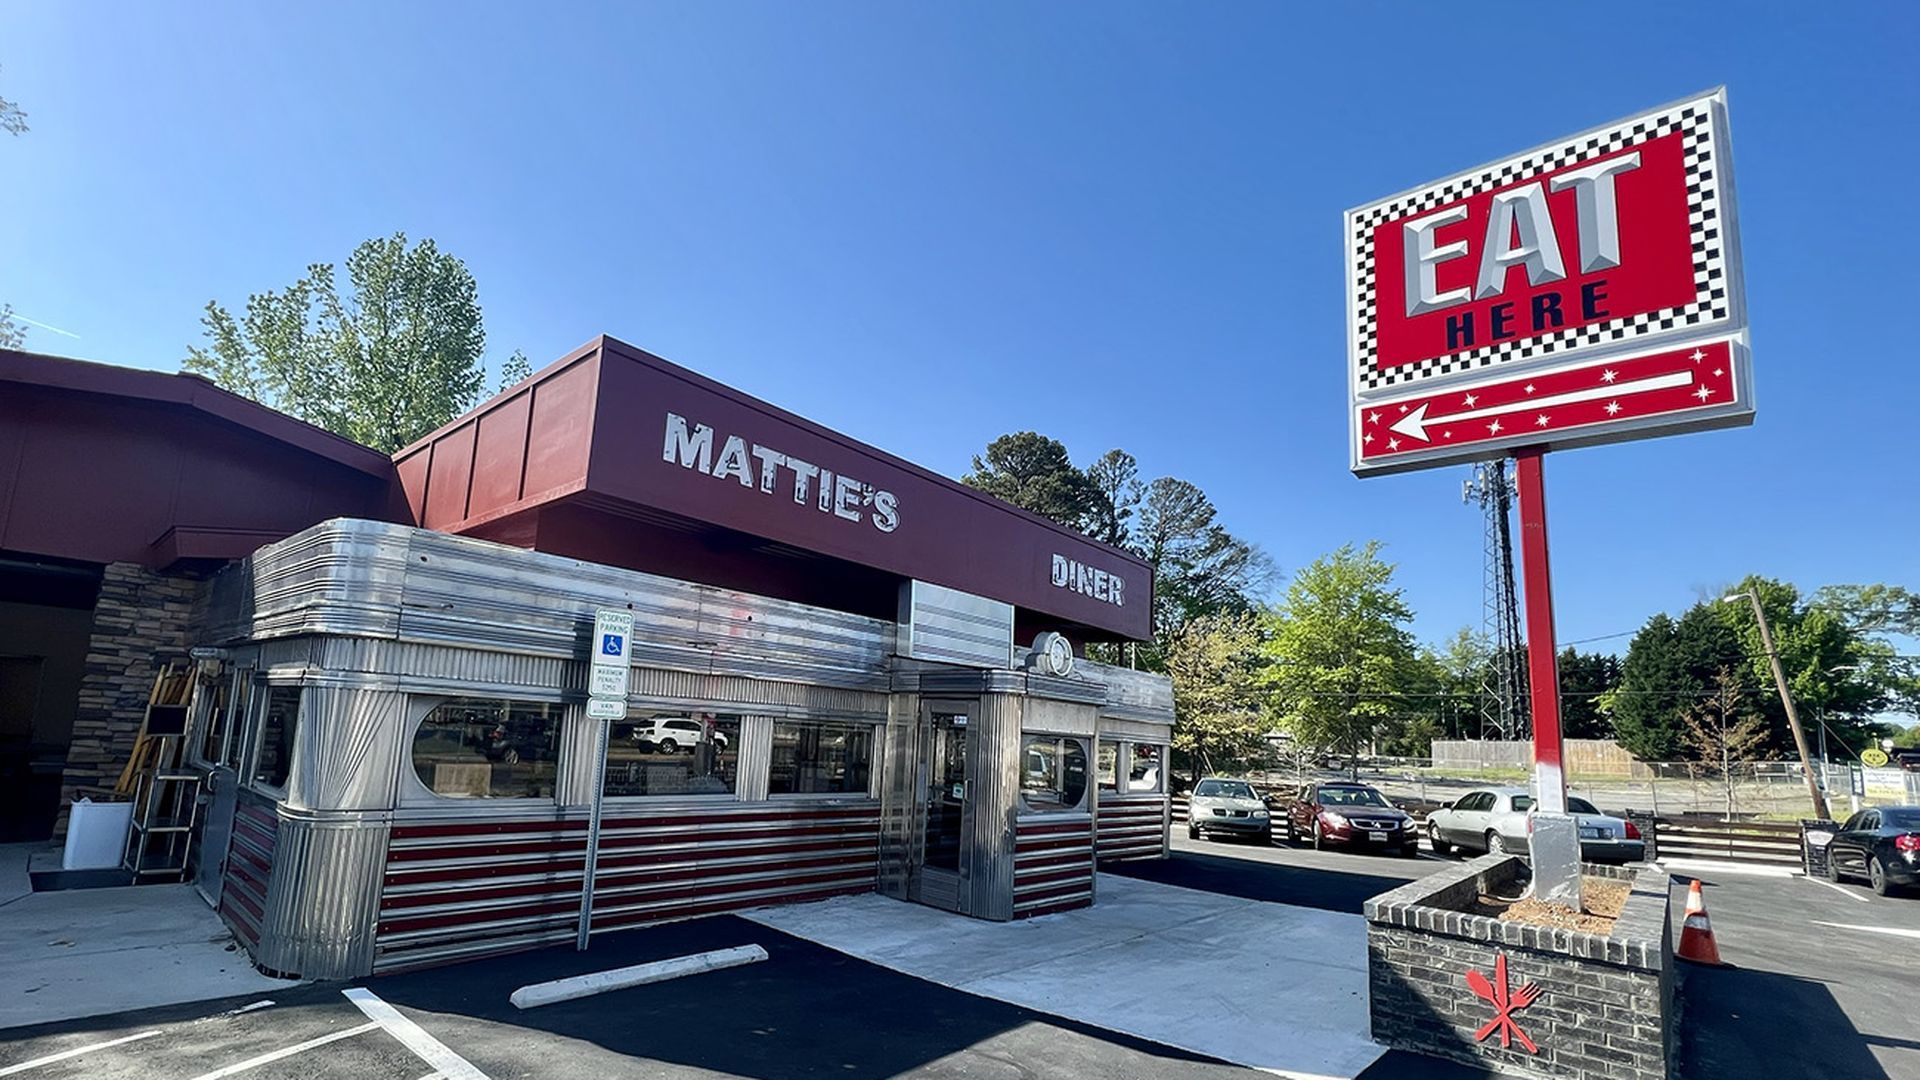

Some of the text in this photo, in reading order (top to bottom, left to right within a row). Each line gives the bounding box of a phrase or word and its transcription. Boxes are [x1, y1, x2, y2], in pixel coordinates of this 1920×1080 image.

[1403, 150, 1641, 318] EAT
[1446, 280, 1611, 350] HERE
[662, 412, 1126, 607] MATTIE'S DINER
[599, 612, 631, 625] RESERVED
[599, 622, 629, 634] PARKING
